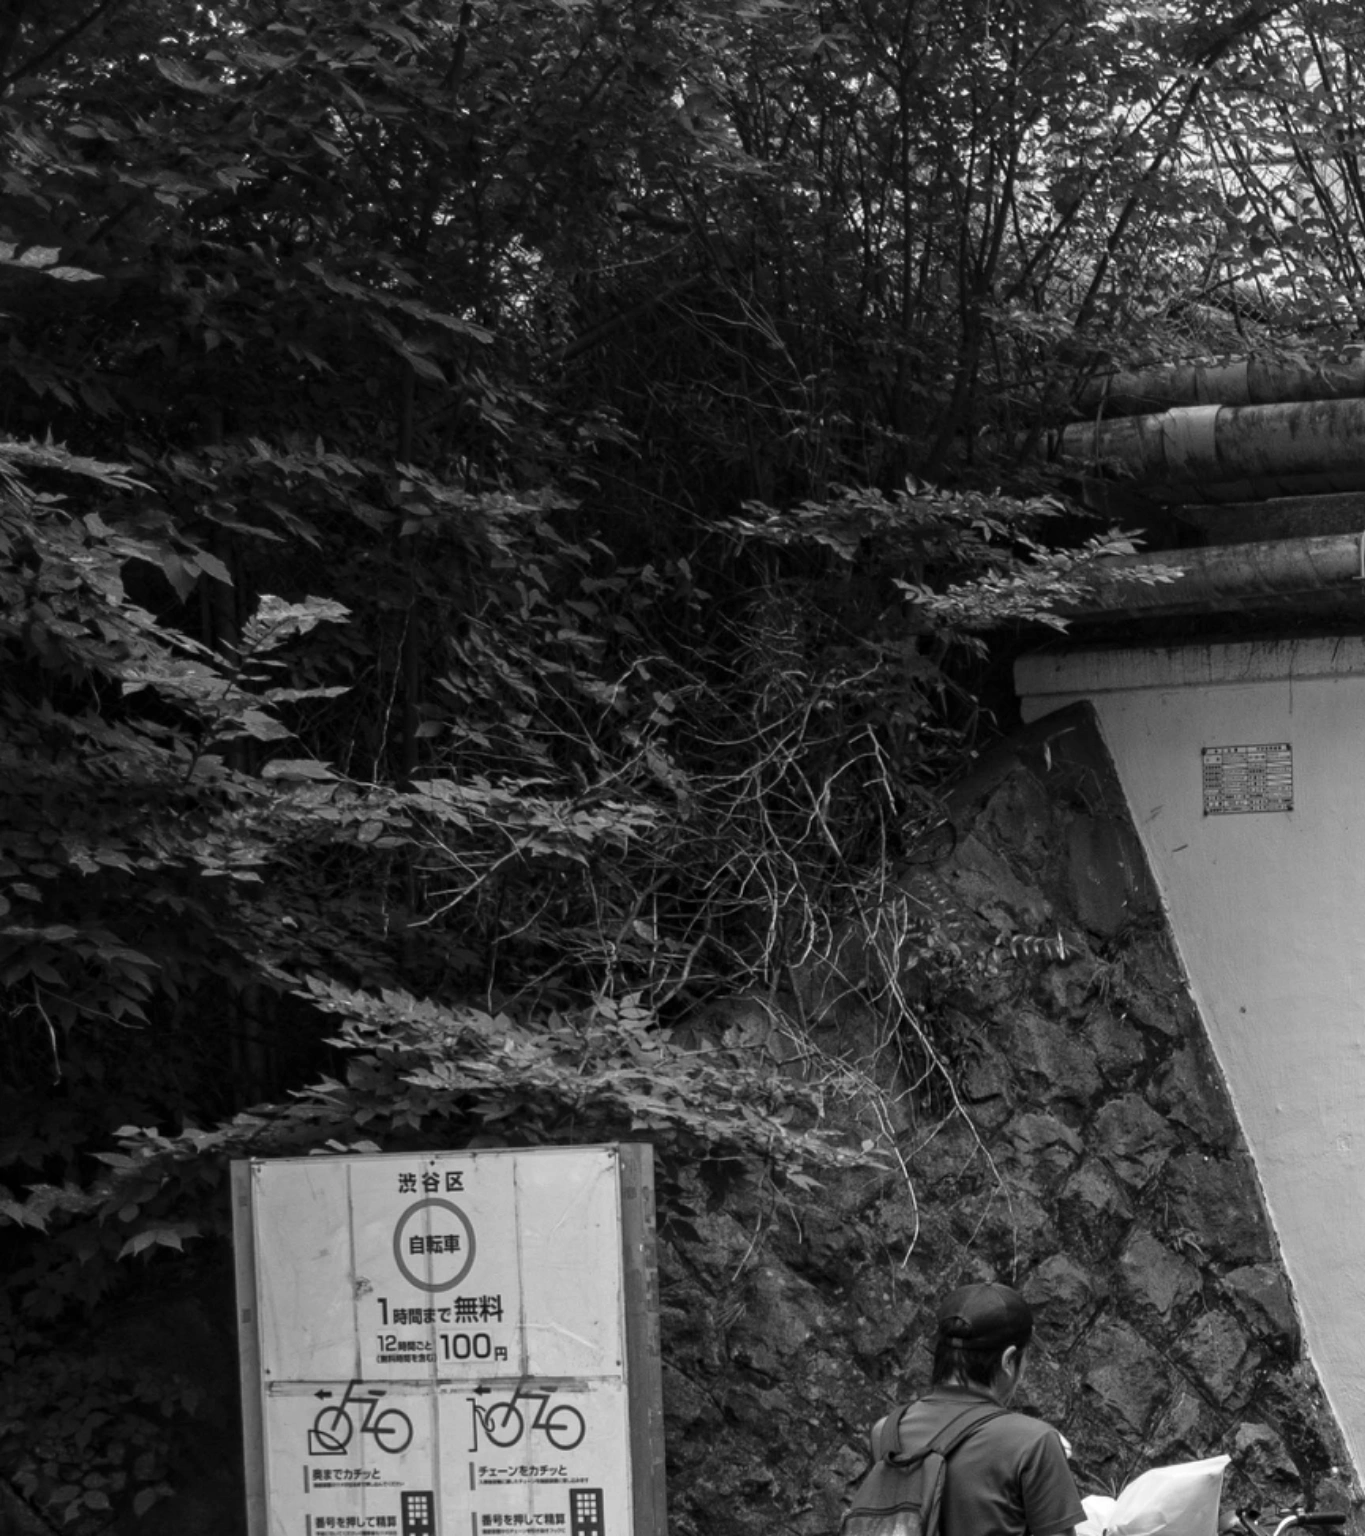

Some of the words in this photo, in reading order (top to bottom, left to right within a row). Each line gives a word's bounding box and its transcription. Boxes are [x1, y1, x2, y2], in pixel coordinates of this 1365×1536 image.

[398, 1170, 465, 1194] 渋谷区
[408, 1233, 462, 1255] 自転車
[376, 1293, 504, 1326] 1時間まで無料
[376, 1333, 434, 1352] 12時間ごと
[439, 1332, 509, 1362] 100円
[478, 1464, 568, 1477] チェーンをカチッと
[315, 1515, 397, 1529] 番号を押して精算
[481, 1513, 566, 1527] 番号を押して精算
